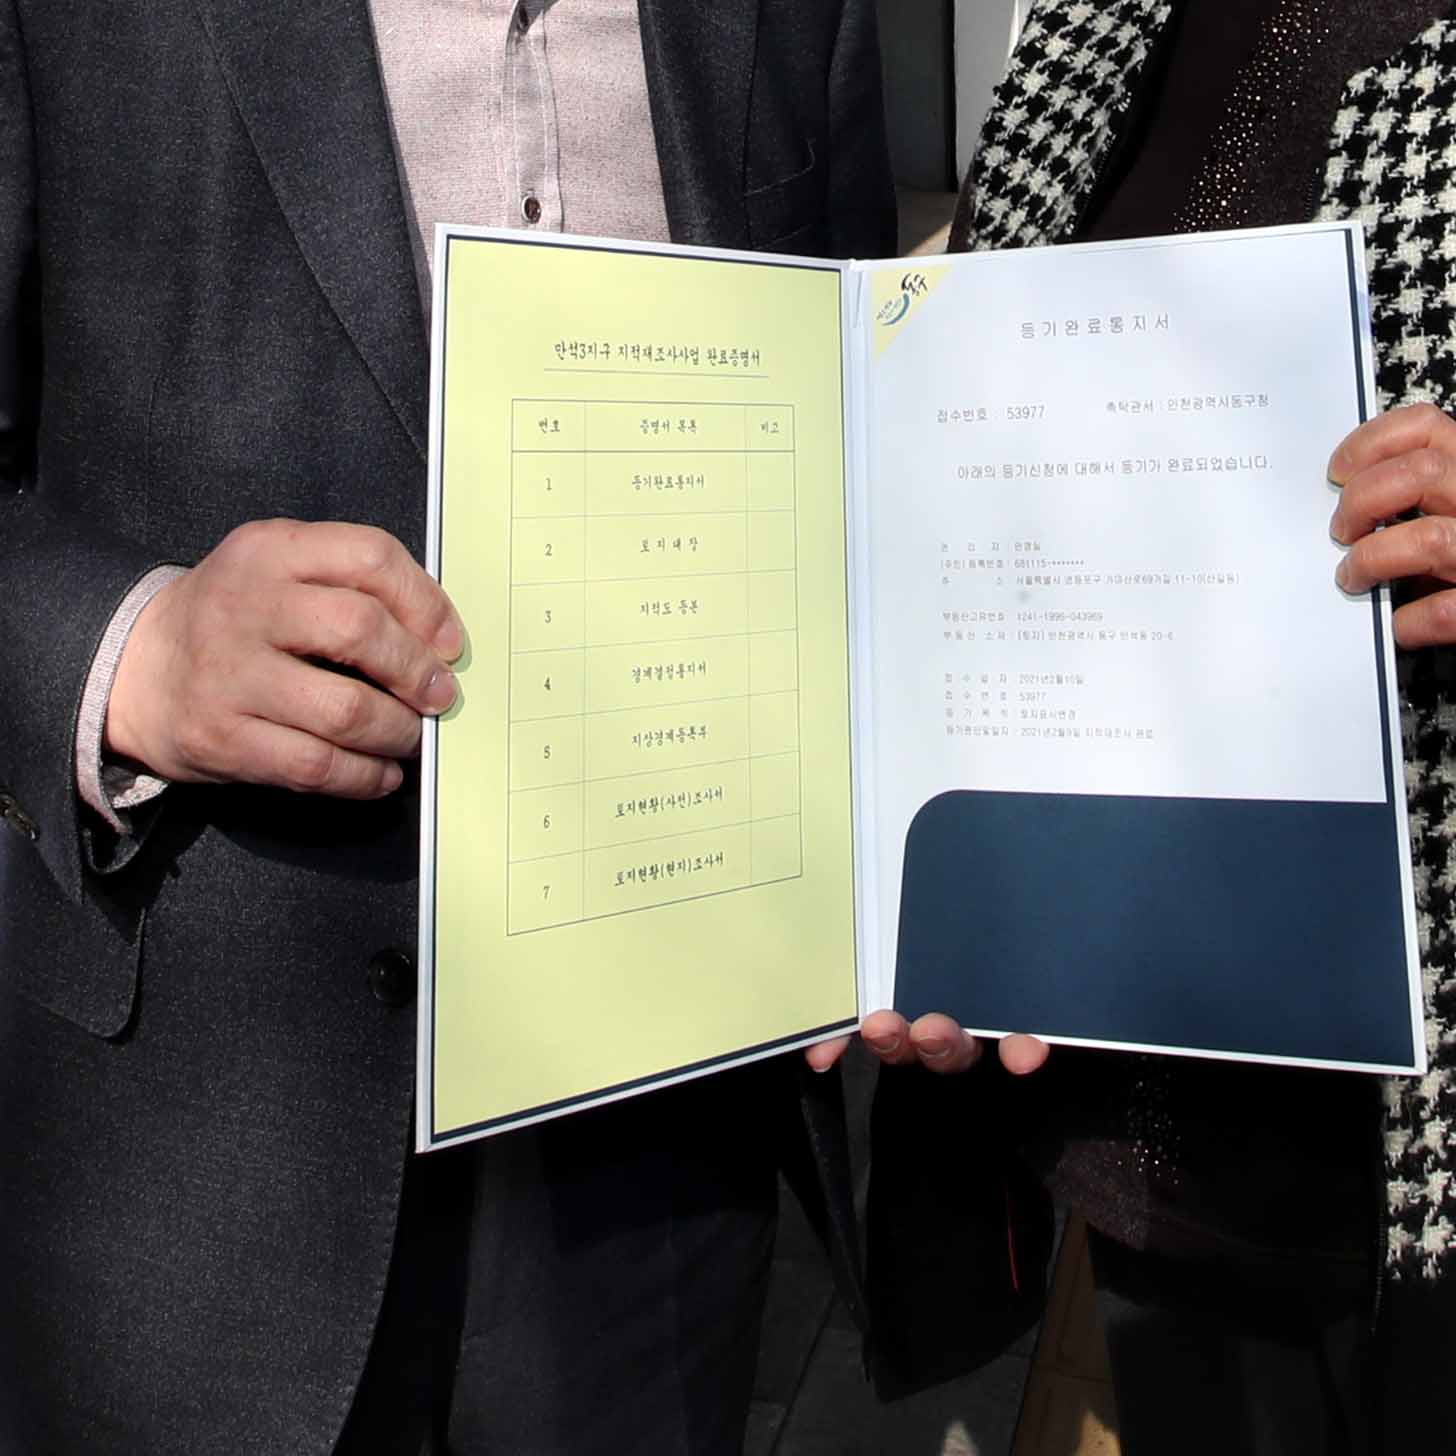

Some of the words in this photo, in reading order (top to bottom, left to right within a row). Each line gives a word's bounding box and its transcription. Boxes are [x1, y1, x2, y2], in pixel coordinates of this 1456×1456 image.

[554, 340, 611, 361] 만석3지구
[617, 343, 700, 366] 지적재조사사업
[545, 477, 553, 492] 1
[544, 543, 553, 557] 2
[544, 609, 552, 624] 3
[543, 677, 552, 691] 4
[543, 744, 551, 760] 5
[543, 814, 551, 829] 6
[543, 885, 551, 900] 7
